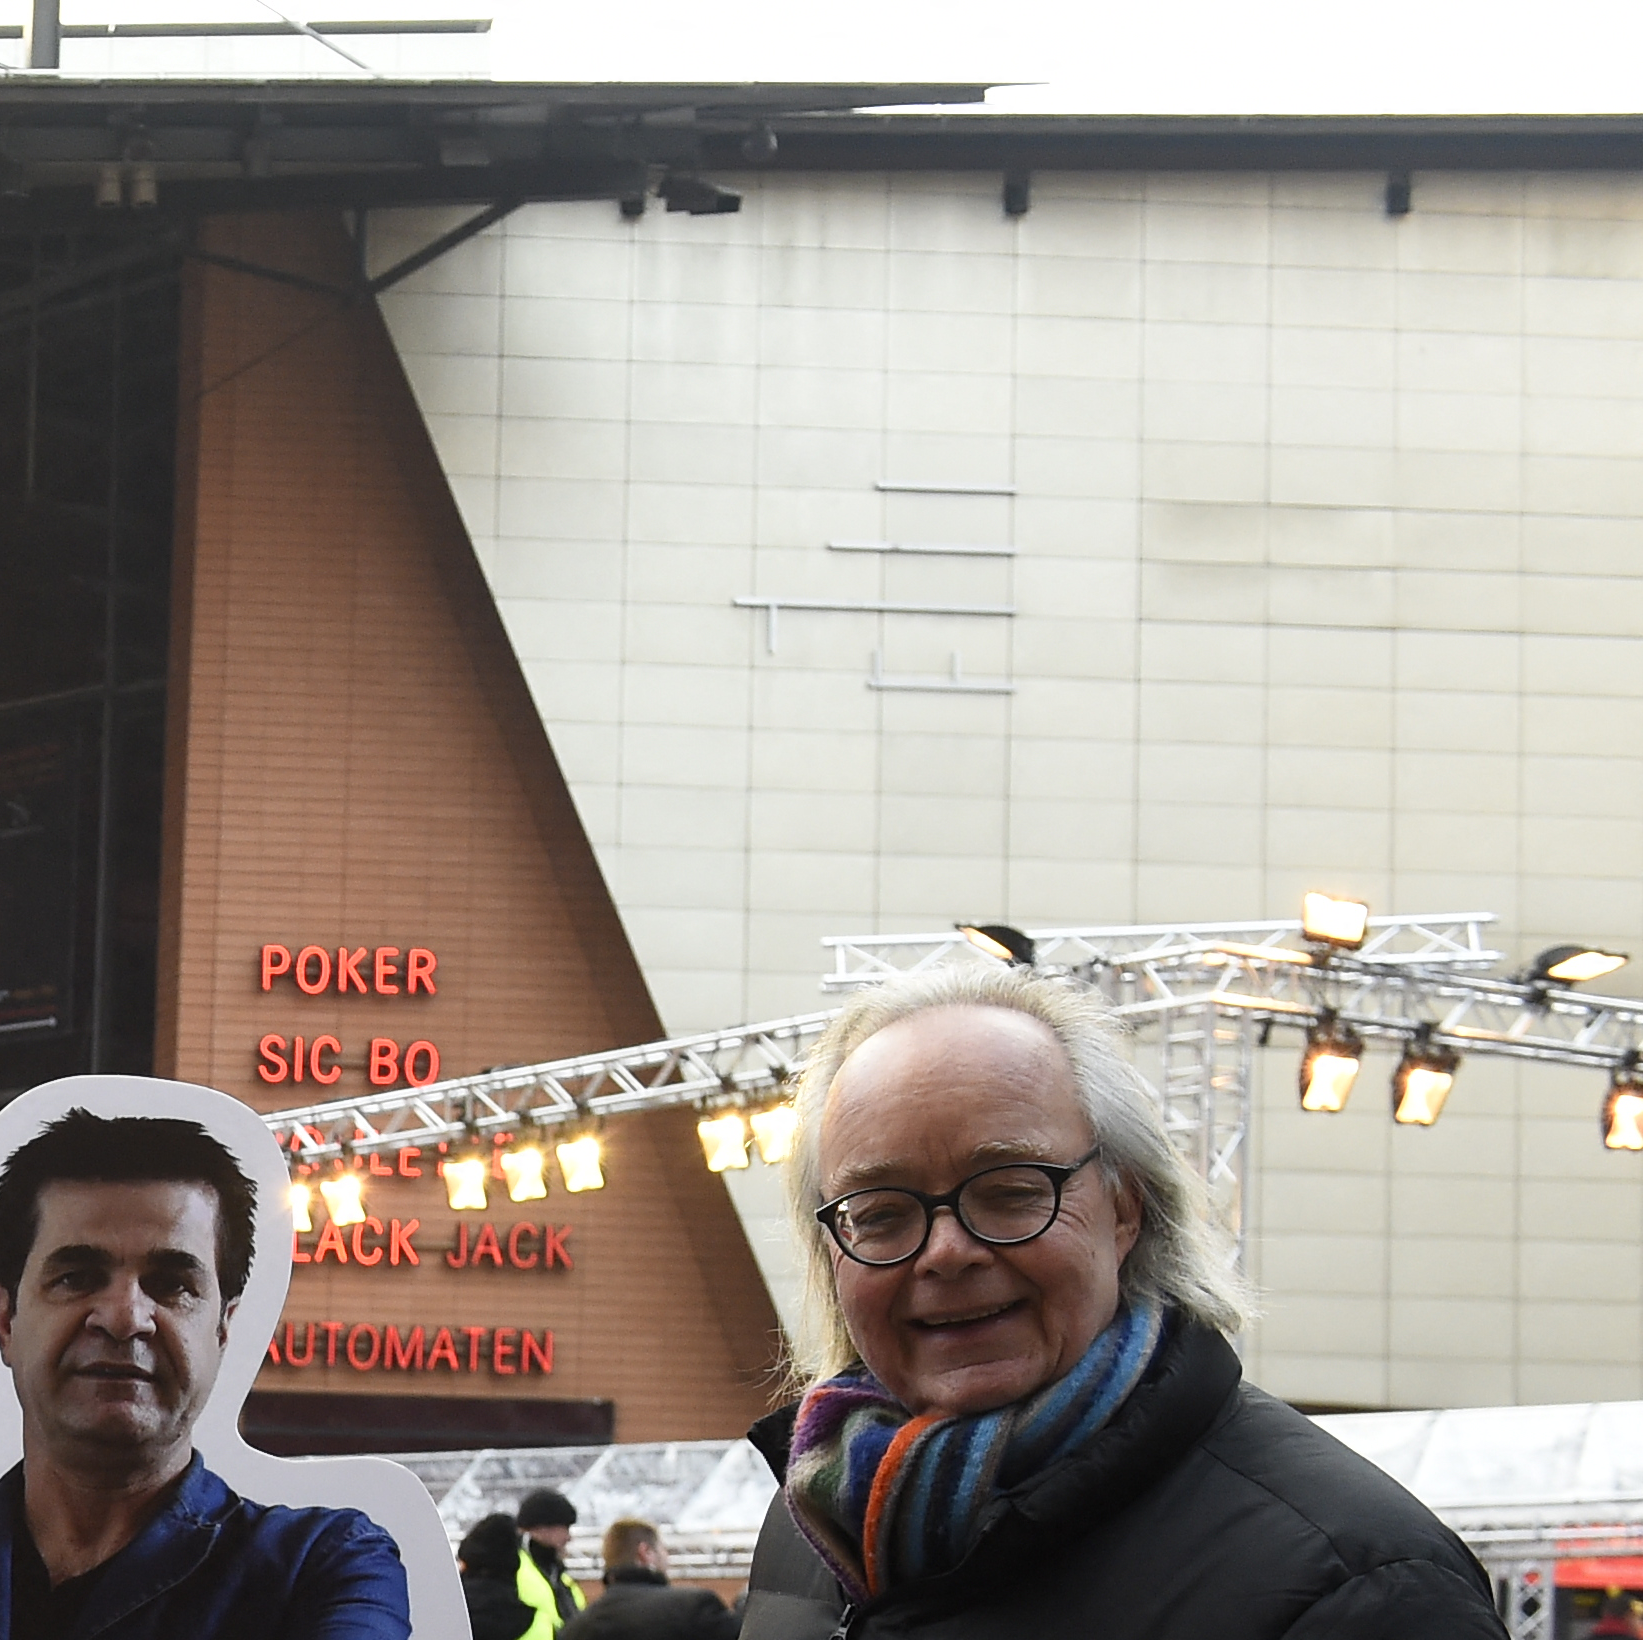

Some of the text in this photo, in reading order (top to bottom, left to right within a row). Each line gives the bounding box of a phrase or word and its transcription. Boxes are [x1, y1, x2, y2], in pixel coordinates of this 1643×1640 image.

[261, 943, 438, 995] POKER
[257, 1033, 440, 1088] SIC BO
[291, 1215, 575, 1270] LACK JACK
